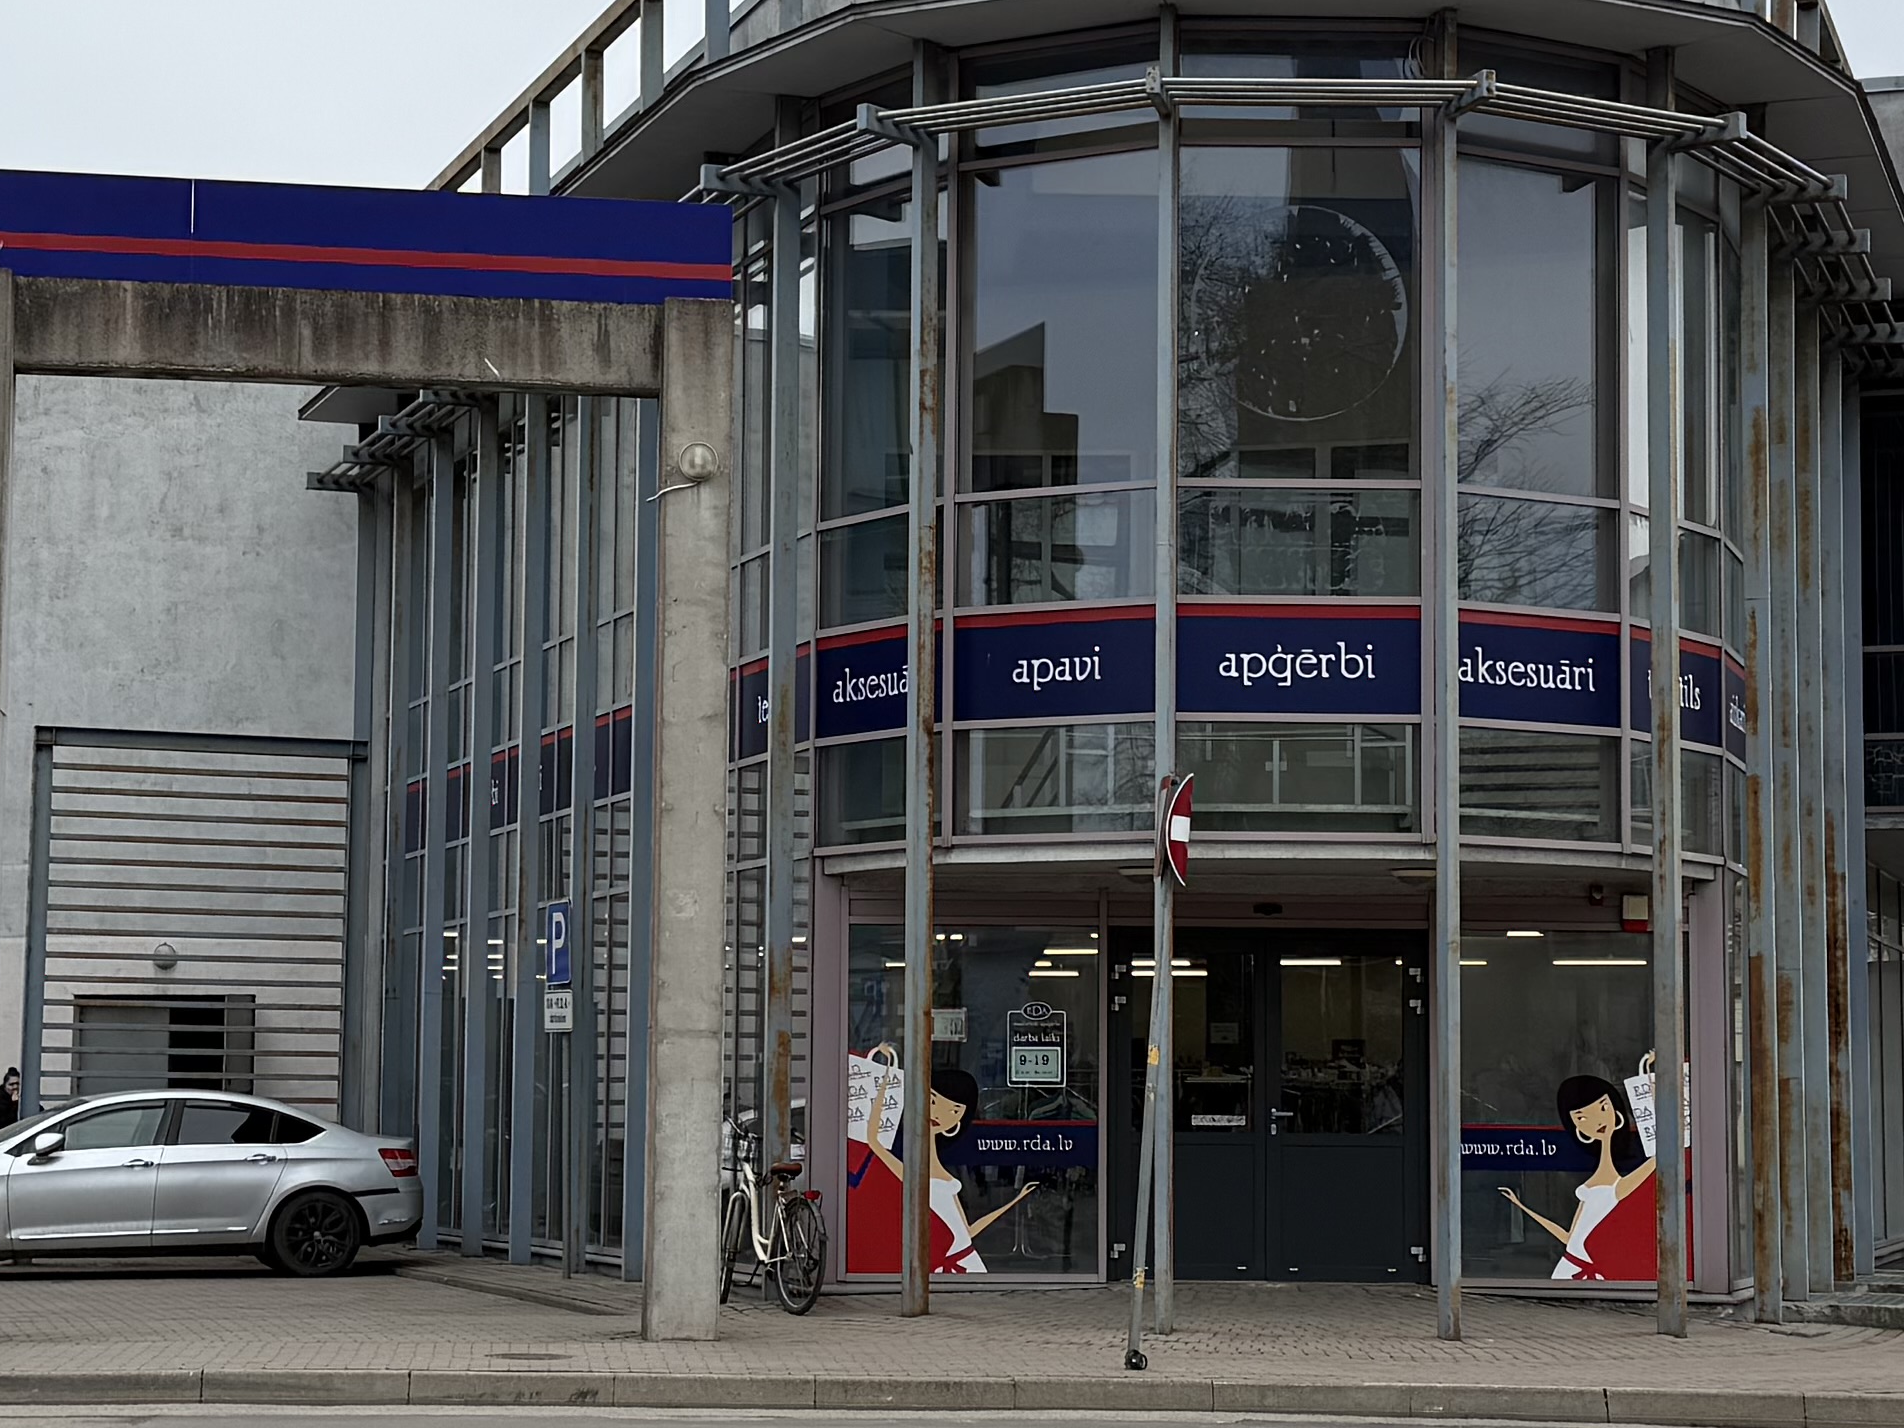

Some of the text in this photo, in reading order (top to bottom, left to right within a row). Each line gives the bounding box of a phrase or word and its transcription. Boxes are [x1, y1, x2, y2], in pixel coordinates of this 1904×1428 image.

[832, 664, 909, 703] aksesuā
[1011, 645, 1101, 691] apavi
[1218, 642, 1376, 687] apģērbi
[1457, 646, 1595, 693] aksesuāri
[1019, 1054, 1050, 1066] 9-19
[977, 1134, 1074, 1151] www.rda.lv
[1459, 1139, 1557, 1156] www.rda.lv
